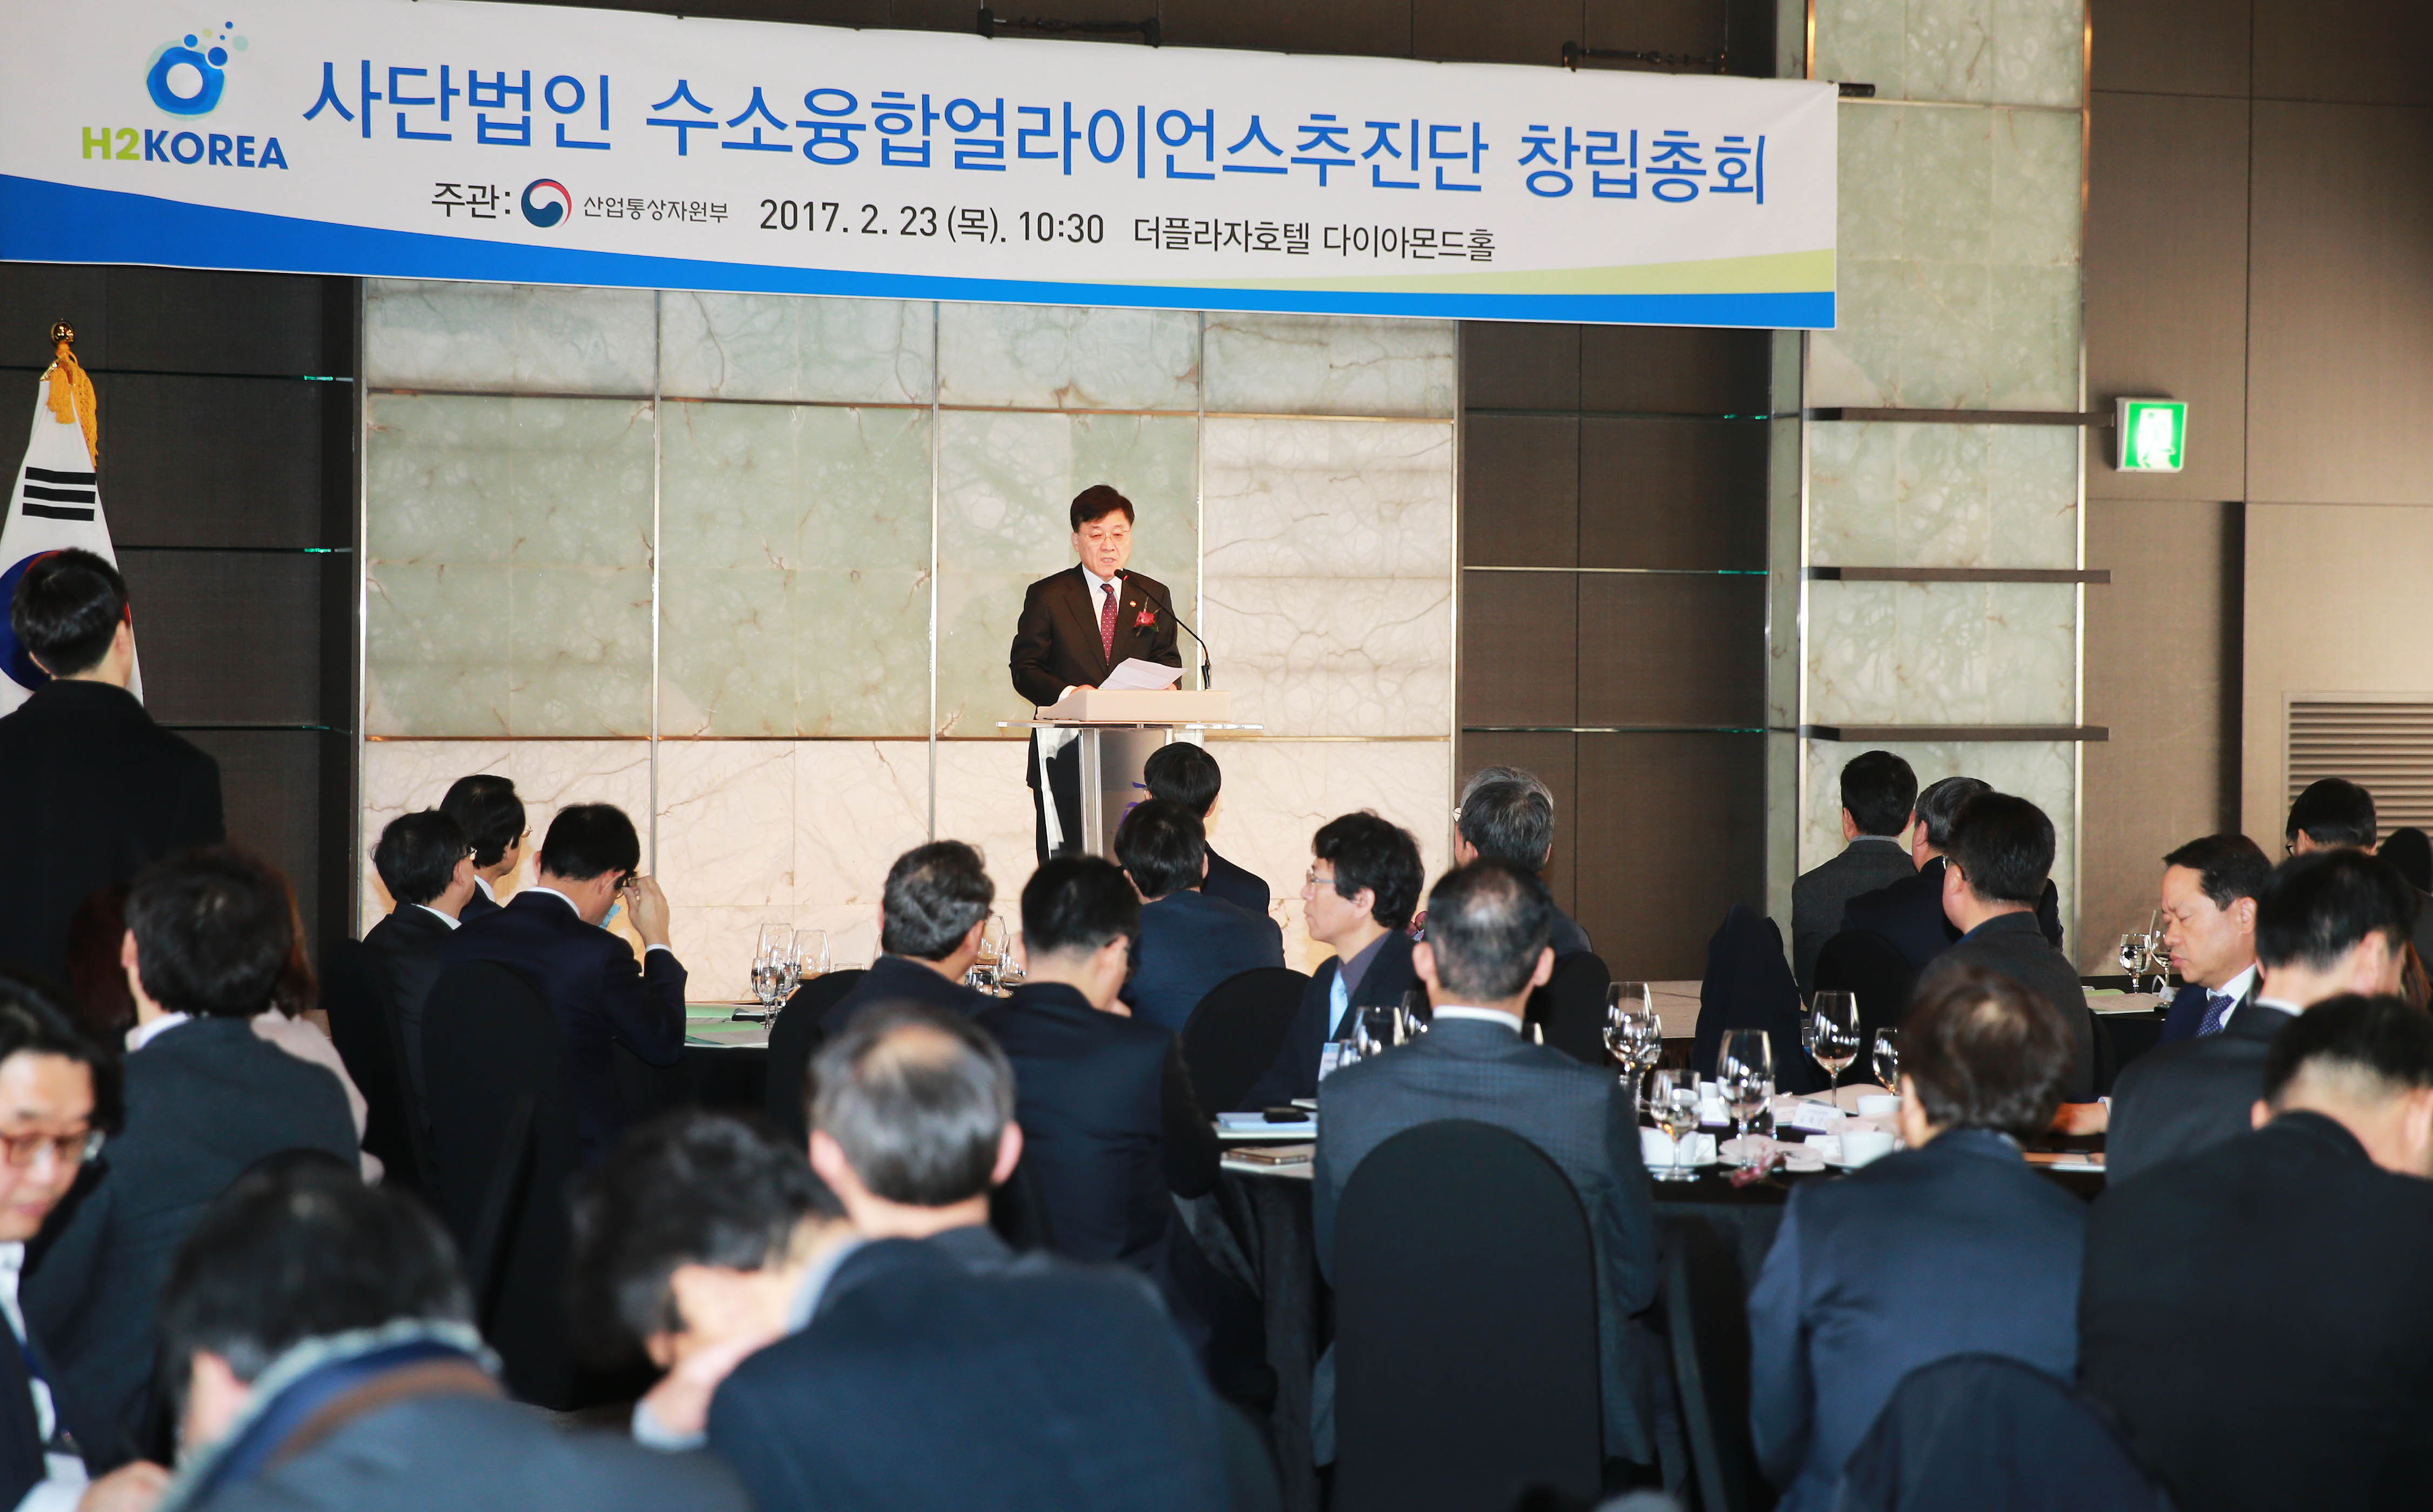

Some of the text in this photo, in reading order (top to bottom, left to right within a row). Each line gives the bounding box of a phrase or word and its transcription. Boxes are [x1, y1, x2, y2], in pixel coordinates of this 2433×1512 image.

[82, 126, 289, 170] H2KOREA
[302, 59, 1765, 205] 사단법인 수소융합얼라이언스추진단 창립총회
[431, 183, 511, 219] 주관:
[584, 197, 728, 223] 산업통상자원부
[760, 199, 848, 233] 2017.
[861, 204, 888, 235] 2.
[1019, 211, 1103, 244] 10:30
[1135, 216, 1495, 262] 더플라자호텔 다이아몬드홀
